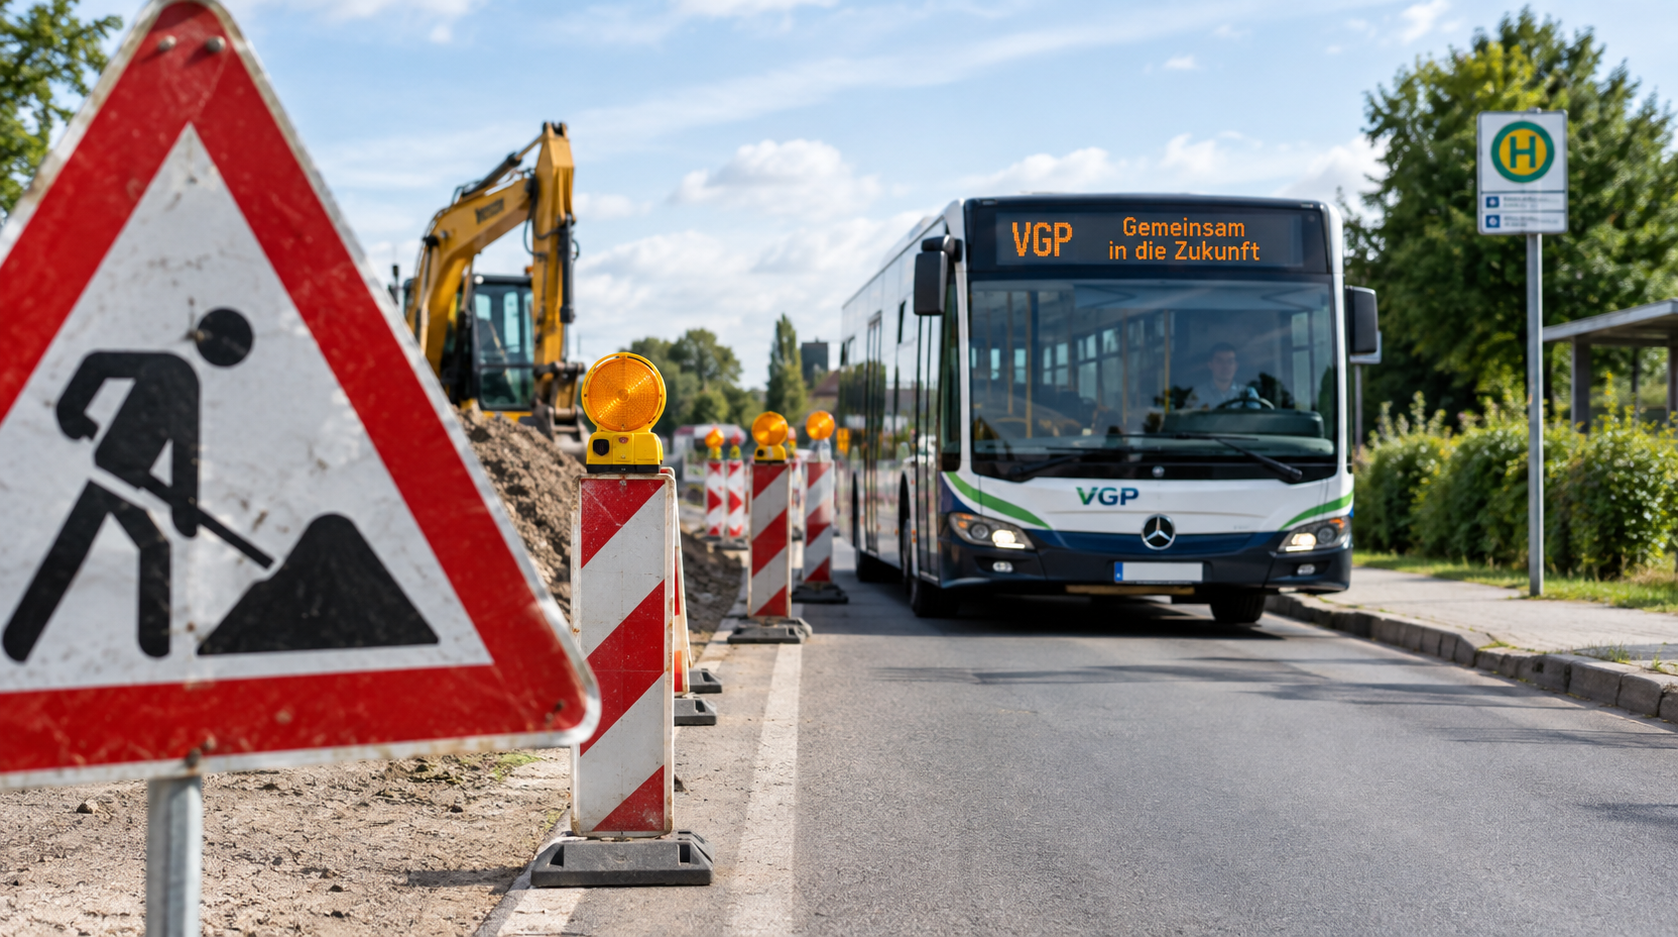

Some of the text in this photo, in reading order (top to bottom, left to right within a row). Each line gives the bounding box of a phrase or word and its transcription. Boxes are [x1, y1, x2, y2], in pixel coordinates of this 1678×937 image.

[1509, 135, 1536, 169] H
[1122, 216, 1245, 238] Gemeinsam
[1011, 221, 1073, 258] VGP
[1108, 240, 1260, 261] in die Zukunft
[1076, 486, 1140, 507] VGP
